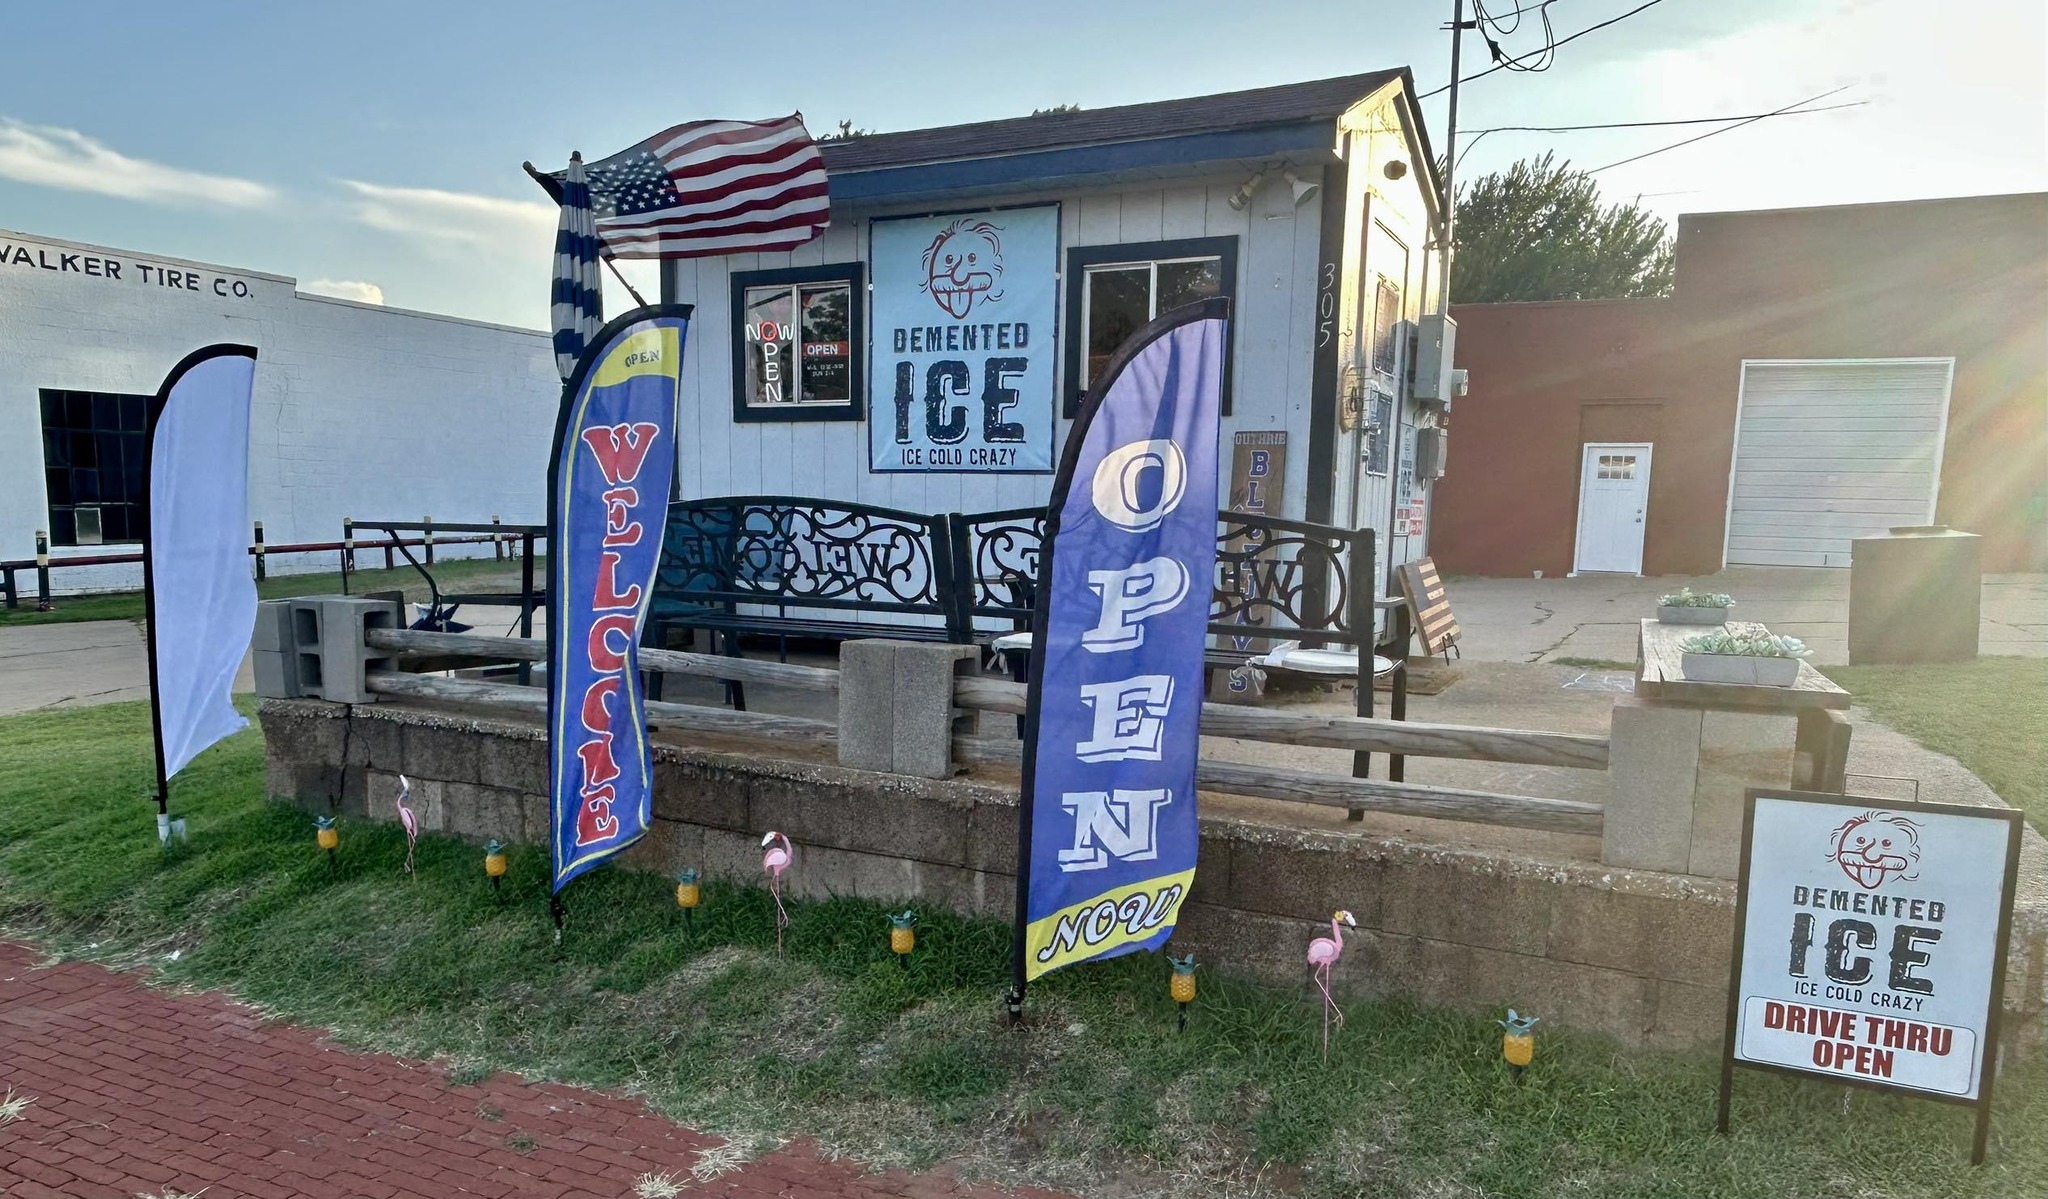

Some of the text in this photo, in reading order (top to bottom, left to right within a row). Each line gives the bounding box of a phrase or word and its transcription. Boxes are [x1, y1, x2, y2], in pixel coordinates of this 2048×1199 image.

[136, 264, 200, 291] TIRE
[213, 278, 254, 298] CO.
[1319, 262, 1336, 348] 305
[745, 321, 795, 342] NOW
[807, 344, 838, 355] OPEN
[893, 322, 1029, 353] DEMENTED
[624, 350, 660, 367] OPEN
[893, 357, 1030, 445] ICE
[902, 448, 1017, 466] ICE COLD CRAZY
[1234, 433, 1287, 446] GUTHRIE
[1058, 438, 1191, 872] OPEN
[1792, 885, 1947, 923] DEMENTED
[1036, 883, 1180, 962] NOW
[1788, 912, 1943, 997] ICE
[1794, 981, 1924, 1012] ICE COLD CRAZY
[1764, 1002, 1953, 1056] DRIVE THRU
[1812, 1040, 1895, 1078] OPEN
